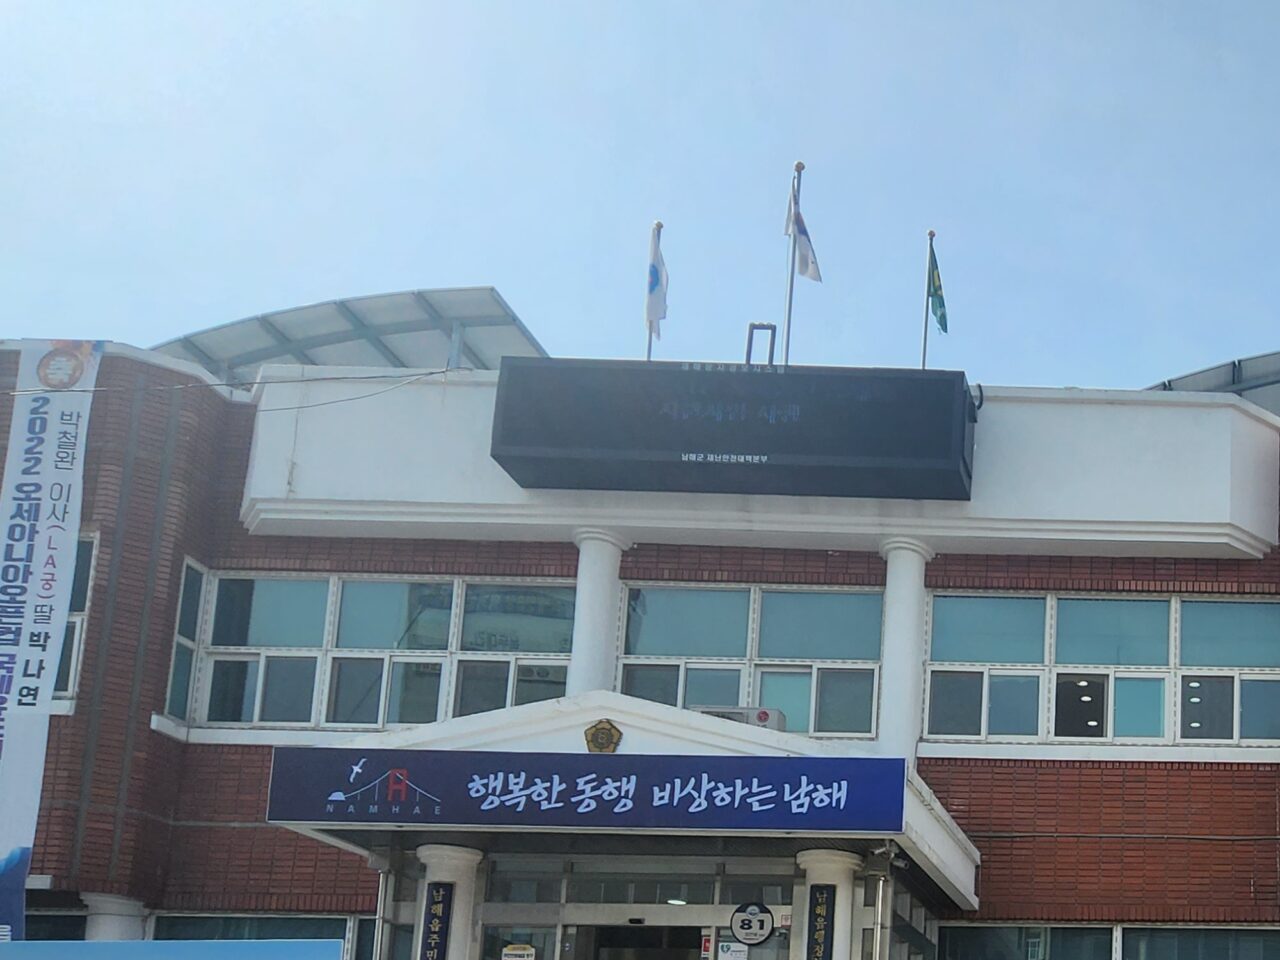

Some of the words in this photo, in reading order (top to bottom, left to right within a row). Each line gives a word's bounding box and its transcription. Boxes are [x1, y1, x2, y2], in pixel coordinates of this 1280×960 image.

[21, 396, 50, 476] 2022
[467, 771, 567, 812] 행복한
[570, 773, 637, 813] 동행
[652, 773, 777, 813] 비상하는
[783, 775, 849, 814] 남해
[326, 804, 441, 815] NAMHAE
[739, 919, 765, 930] 81
